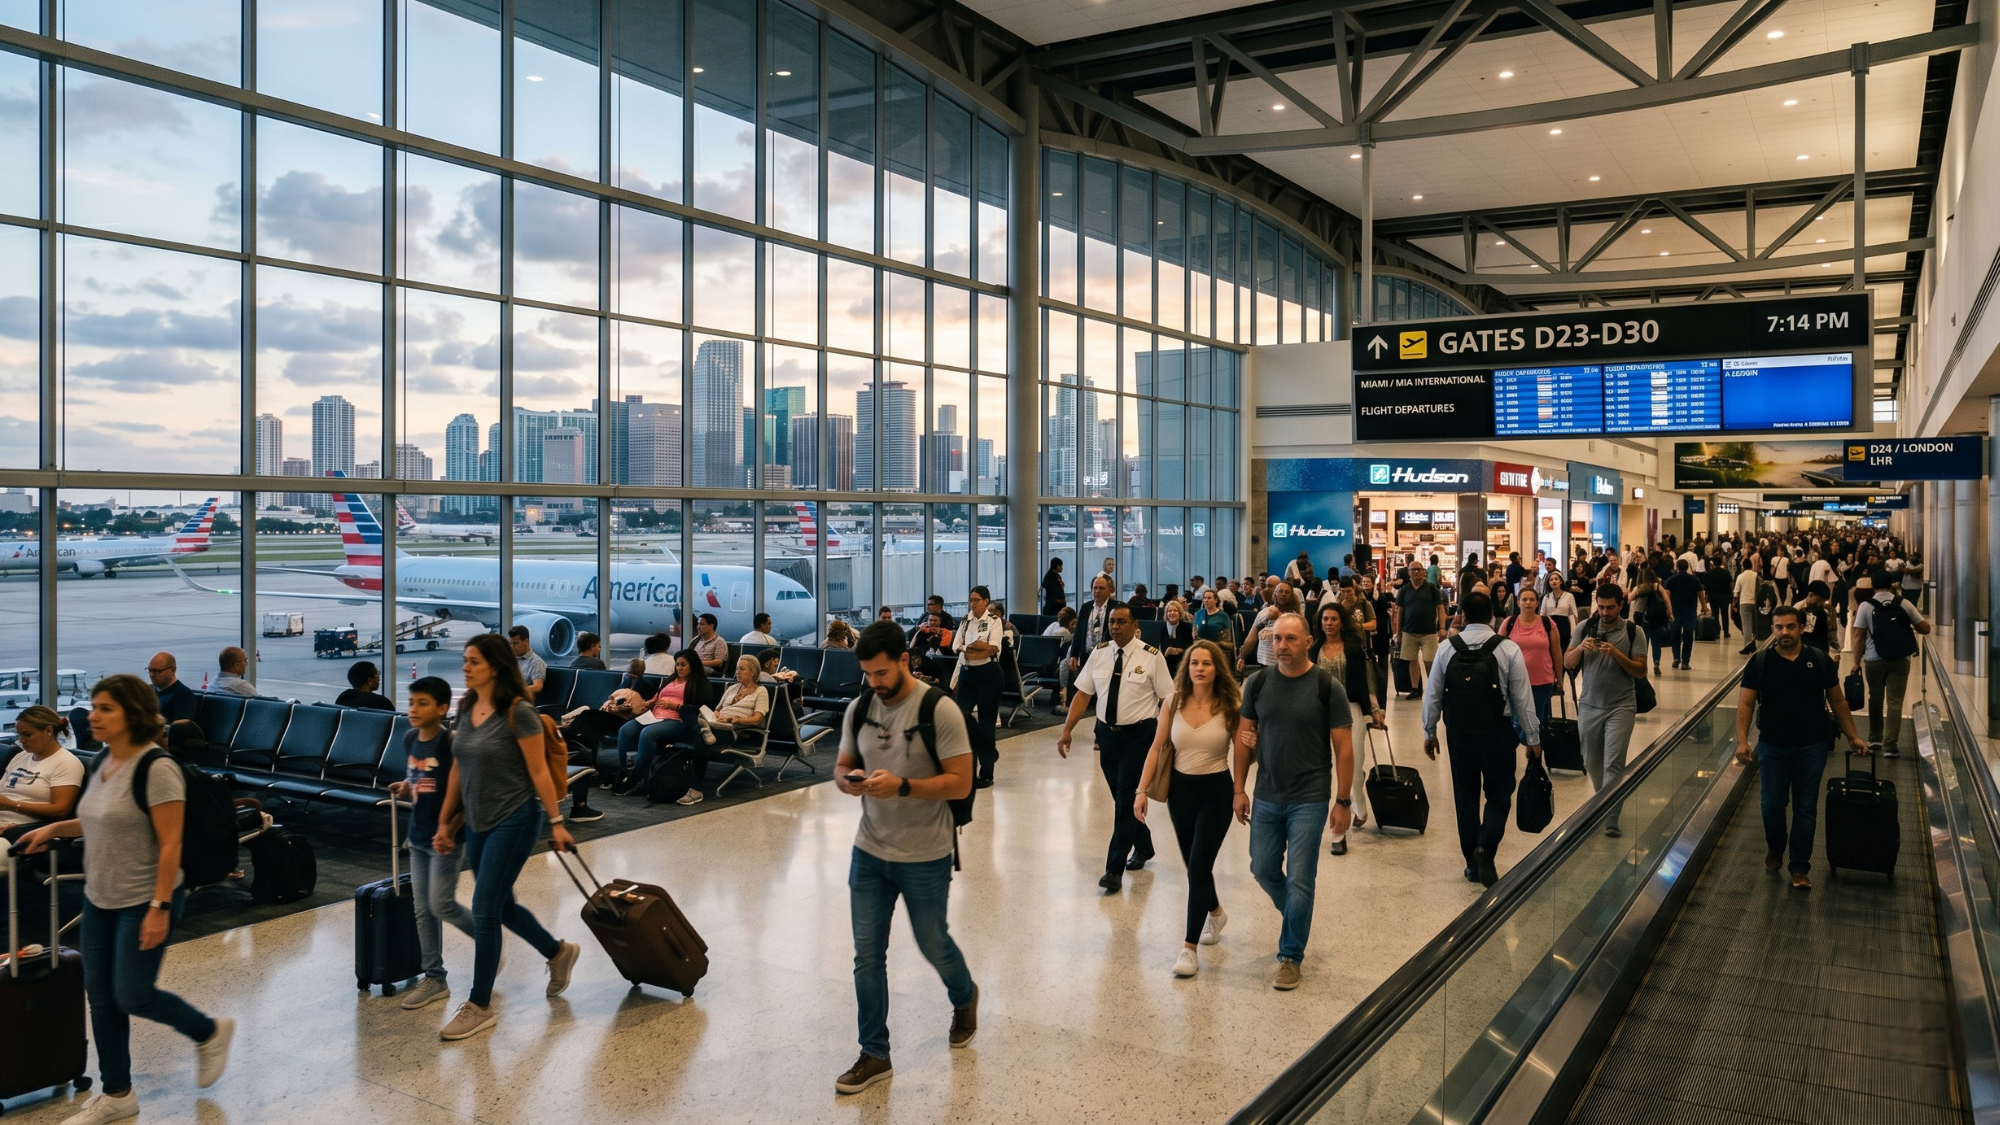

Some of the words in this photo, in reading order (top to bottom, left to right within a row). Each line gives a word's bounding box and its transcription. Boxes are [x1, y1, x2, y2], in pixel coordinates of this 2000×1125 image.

[1767, 314, 1810, 332] 7:14
[1816, 311, 1849, 329] PM
[1438, 328, 1525, 354] GATES
[1535, 319, 1660, 349] D23-D30
[1360, 379, 1389, 388] MIAMI
[1395, 378, 1414, 387] MIA
[1415, 375, 1486, 386] INTERNATIONAL
[1361, 405, 1393, 416] FLIGHT
[1394, 403, 1455, 414] DEPARTURES
[1870, 444, 1892, 454] D24
[1894, 443, 1900, 454] /
[1902, 442, 1954, 453] LONDON
[1870, 456, 1893, 466] LHR
[1391, 467, 1469, 483] Hudson
[1289, 524, 1346, 537] Hudson
[26, 548, 76, 558] Acan
[583, 575, 682, 603] America
